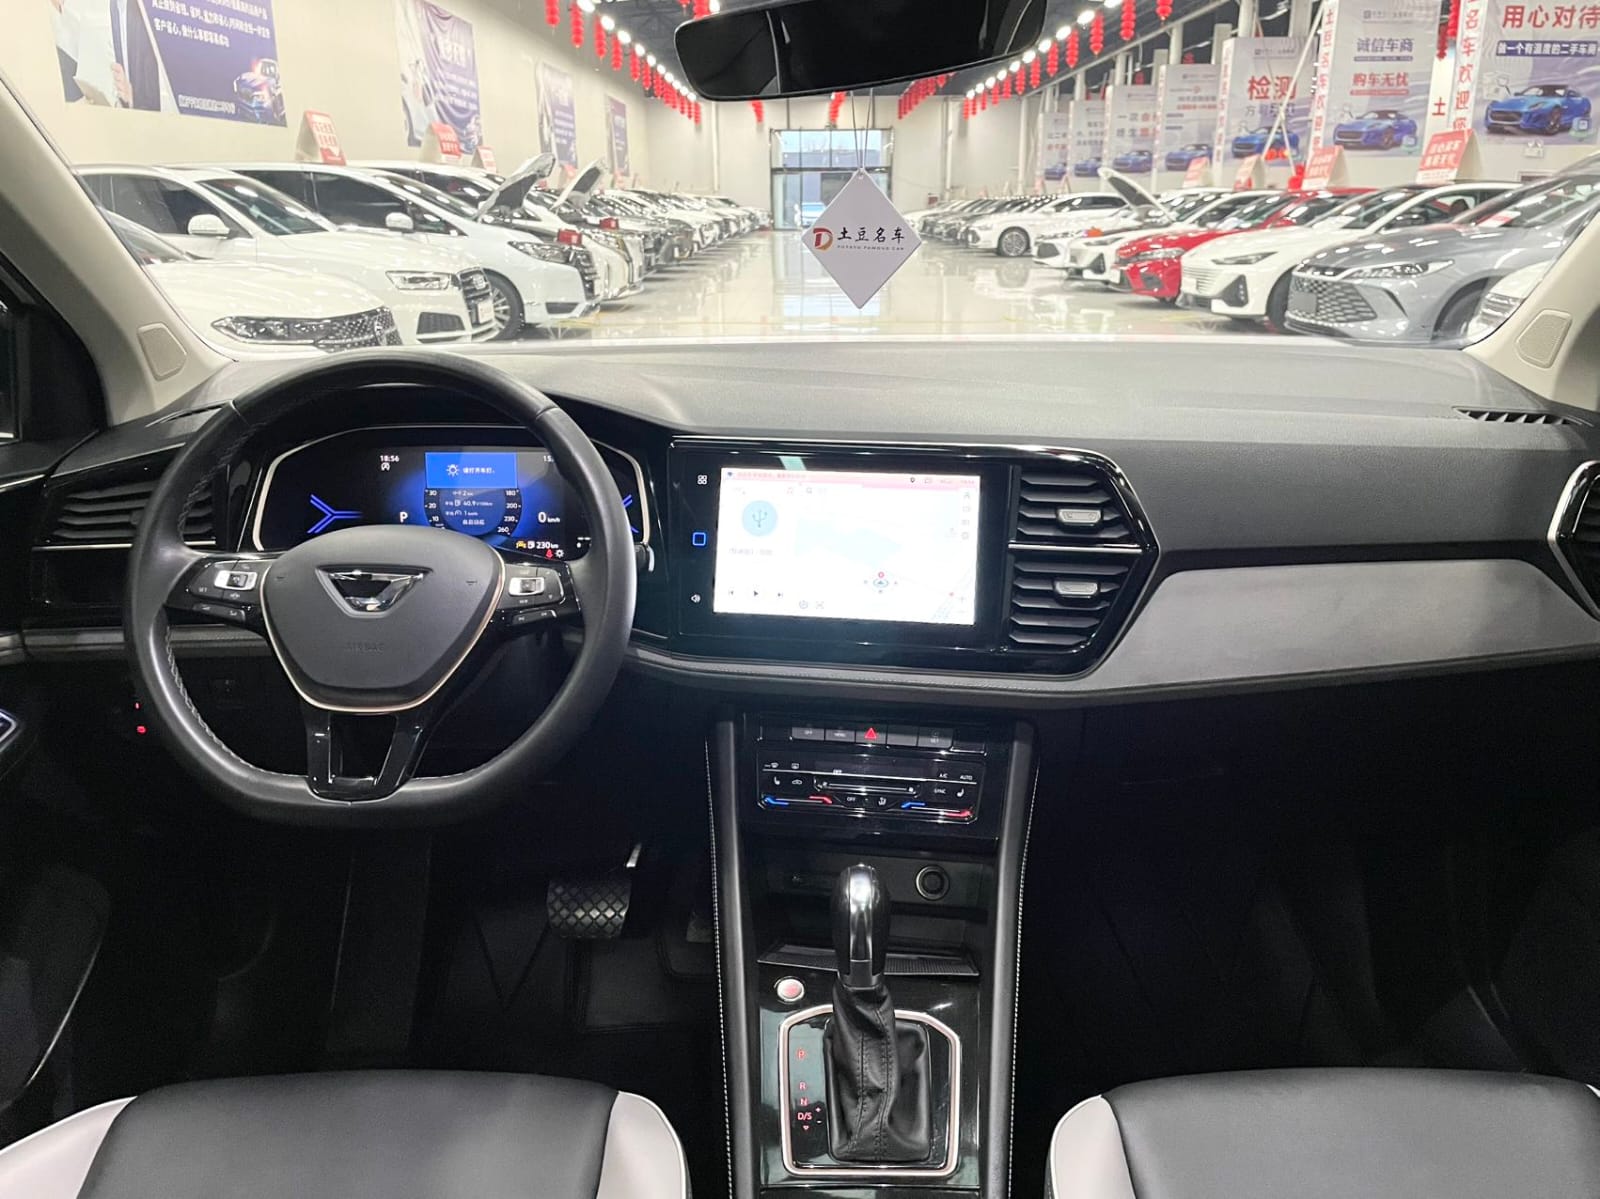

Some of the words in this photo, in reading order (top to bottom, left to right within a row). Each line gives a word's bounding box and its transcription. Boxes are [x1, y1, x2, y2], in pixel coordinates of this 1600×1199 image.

[1502, 5, 1600, 29] 用心对待
[837, 226, 905, 243] 土豆名车
[400, 511, 409, 523] P
[538, 511, 547, 523] 0
[797, 1049, 806, 1060] P
[799, 1082, 807, 1091] R
[800, 1097, 808, 1107] N
[797, 1112, 813, 1120] D/S
